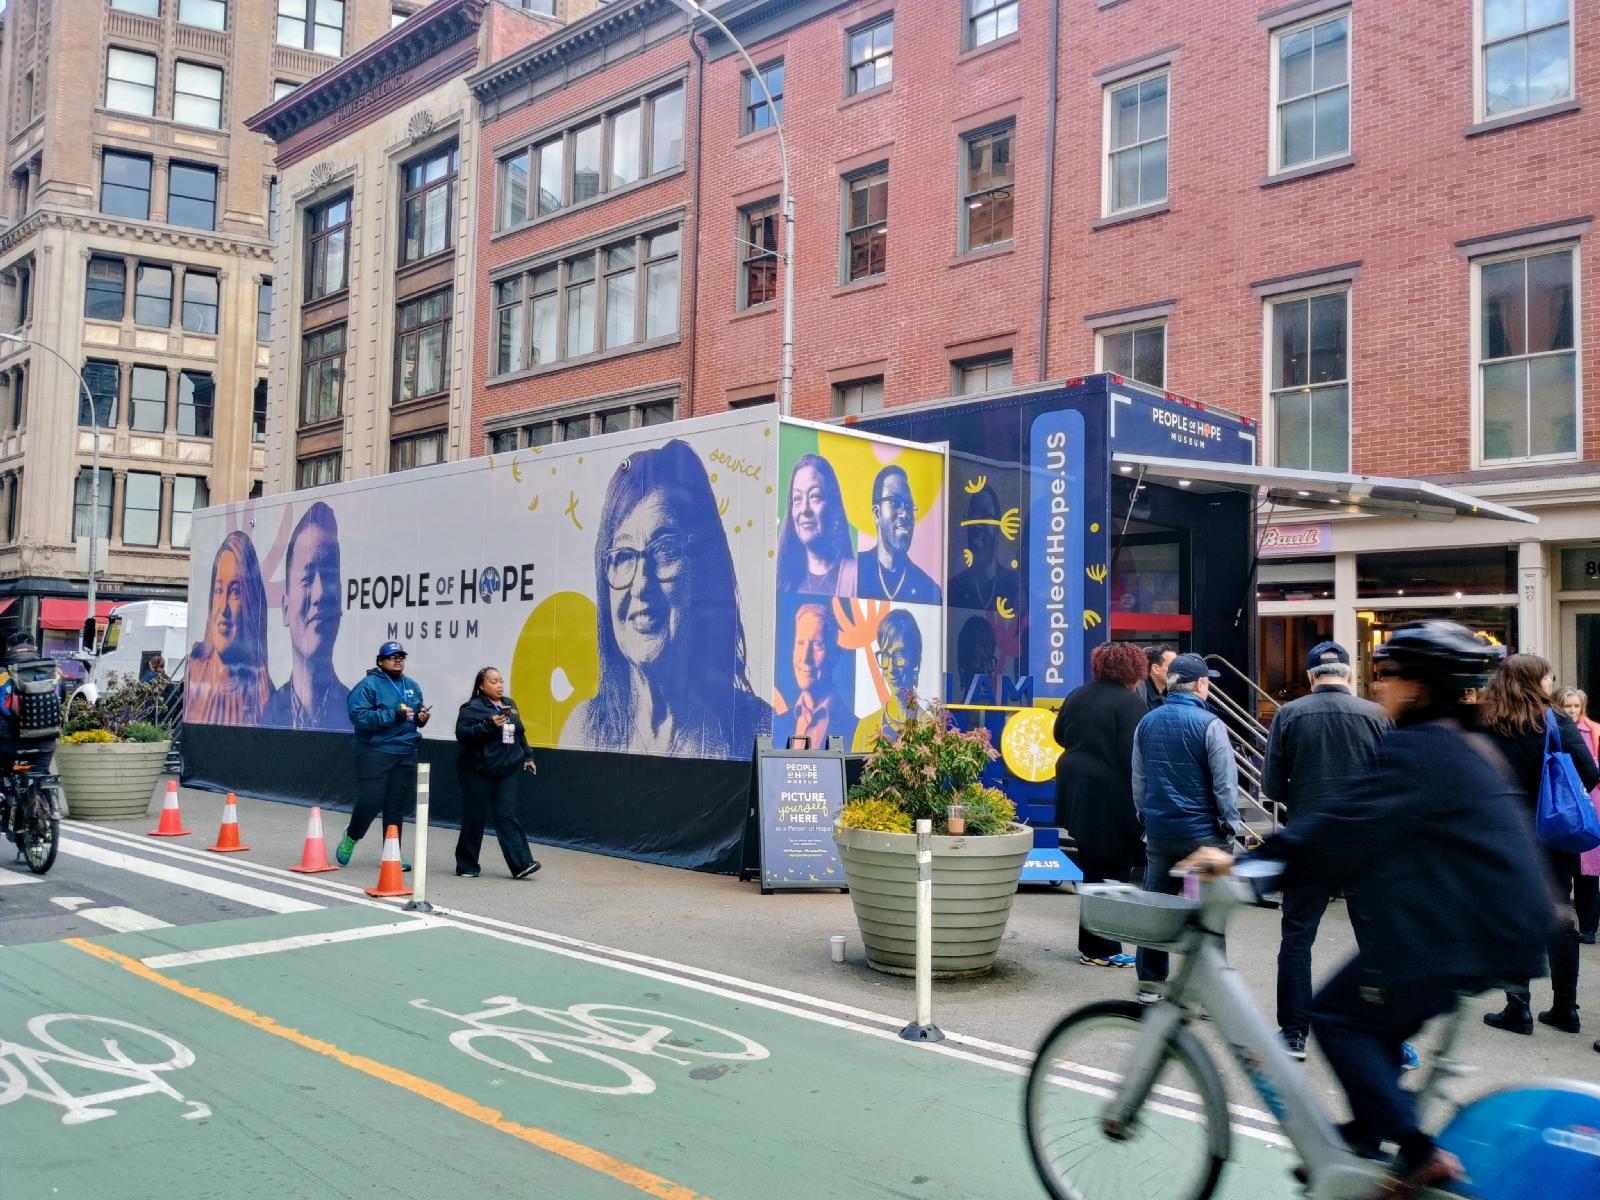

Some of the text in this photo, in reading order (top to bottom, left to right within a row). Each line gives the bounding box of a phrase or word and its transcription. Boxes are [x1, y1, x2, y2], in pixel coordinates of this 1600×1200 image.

[1152, 407, 1221, 441] PEOPLE OF HOPE
[1171, 432, 1205, 449] MUSEUM
[709, 447, 762, 481] service
[1586, 561, 1600, 576] 8
[346, 563, 535, 610] PEOPLE OF HOPE
[387, 619, 479, 640] MUSEUM
[786, 763, 818, 771] PEOPLE
[781, 792, 825, 801] PICTURE
[777, 799, 829, 822] yourself
[790, 813, 819, 823] HERE
